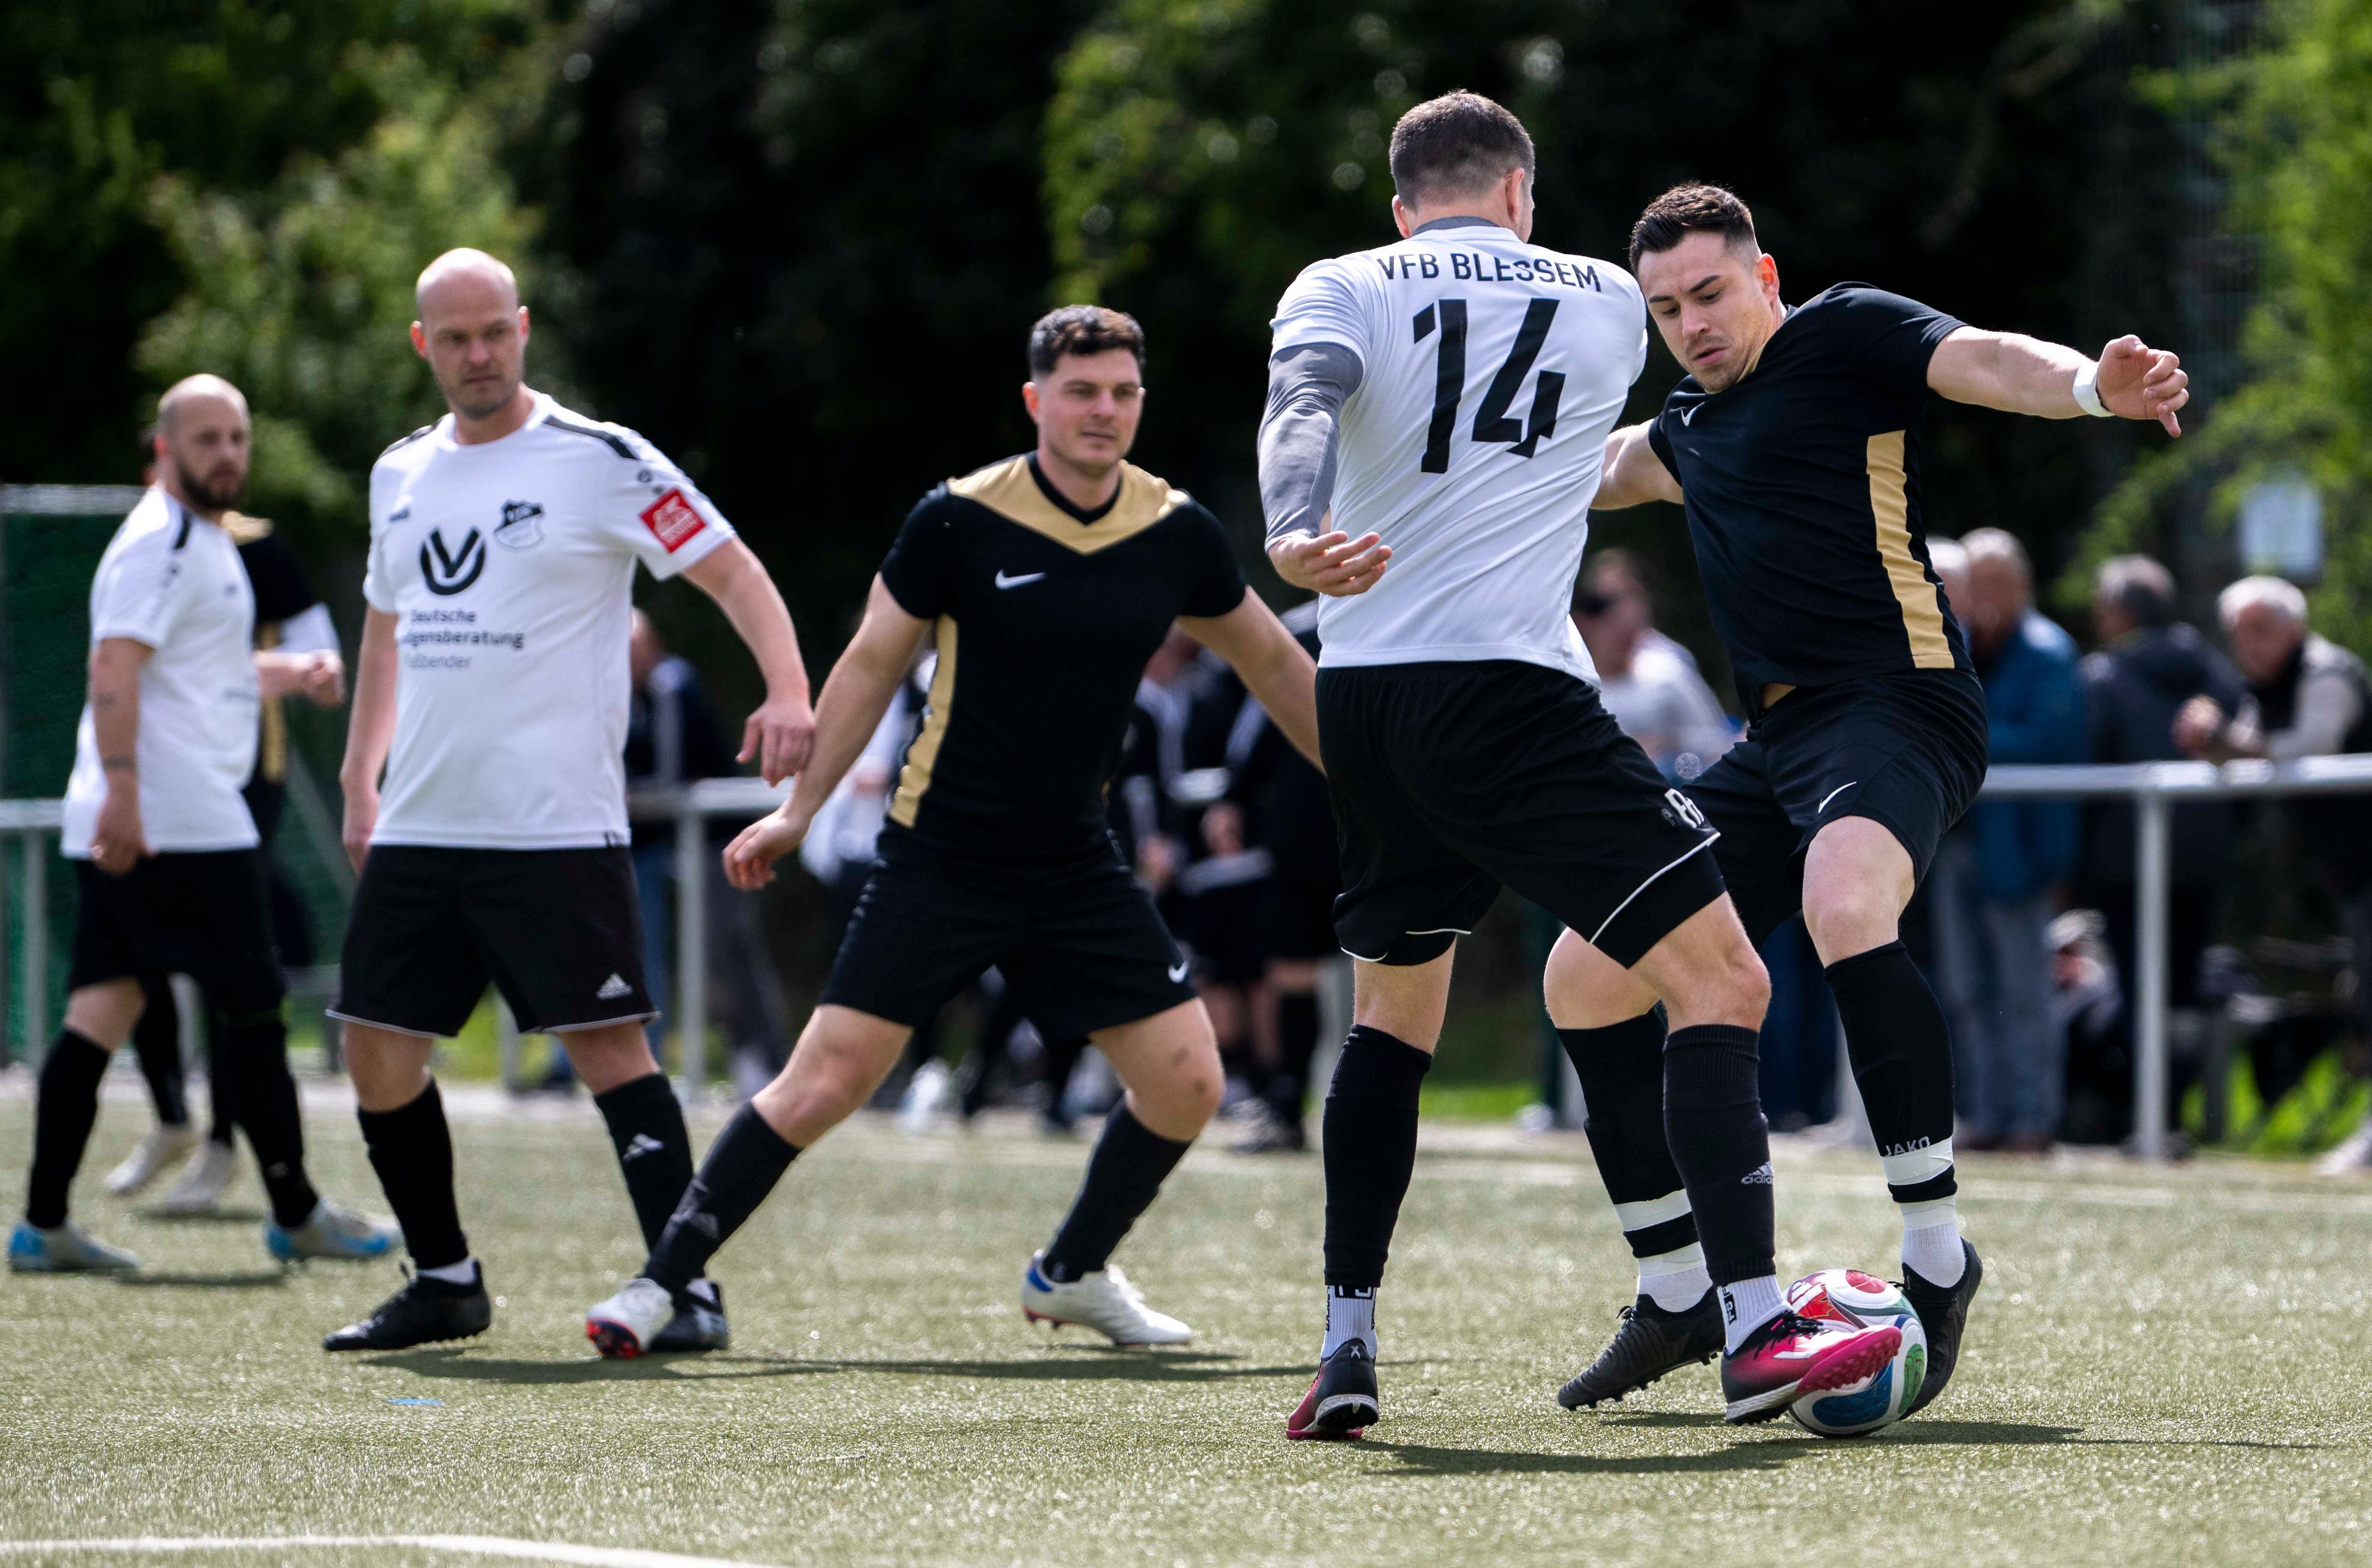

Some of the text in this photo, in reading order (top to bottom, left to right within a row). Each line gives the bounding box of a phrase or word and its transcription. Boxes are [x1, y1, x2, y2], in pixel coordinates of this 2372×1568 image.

[1377, 253, 1602, 292] VFB BLESSEM
[1413, 297, 1566, 474] 14
